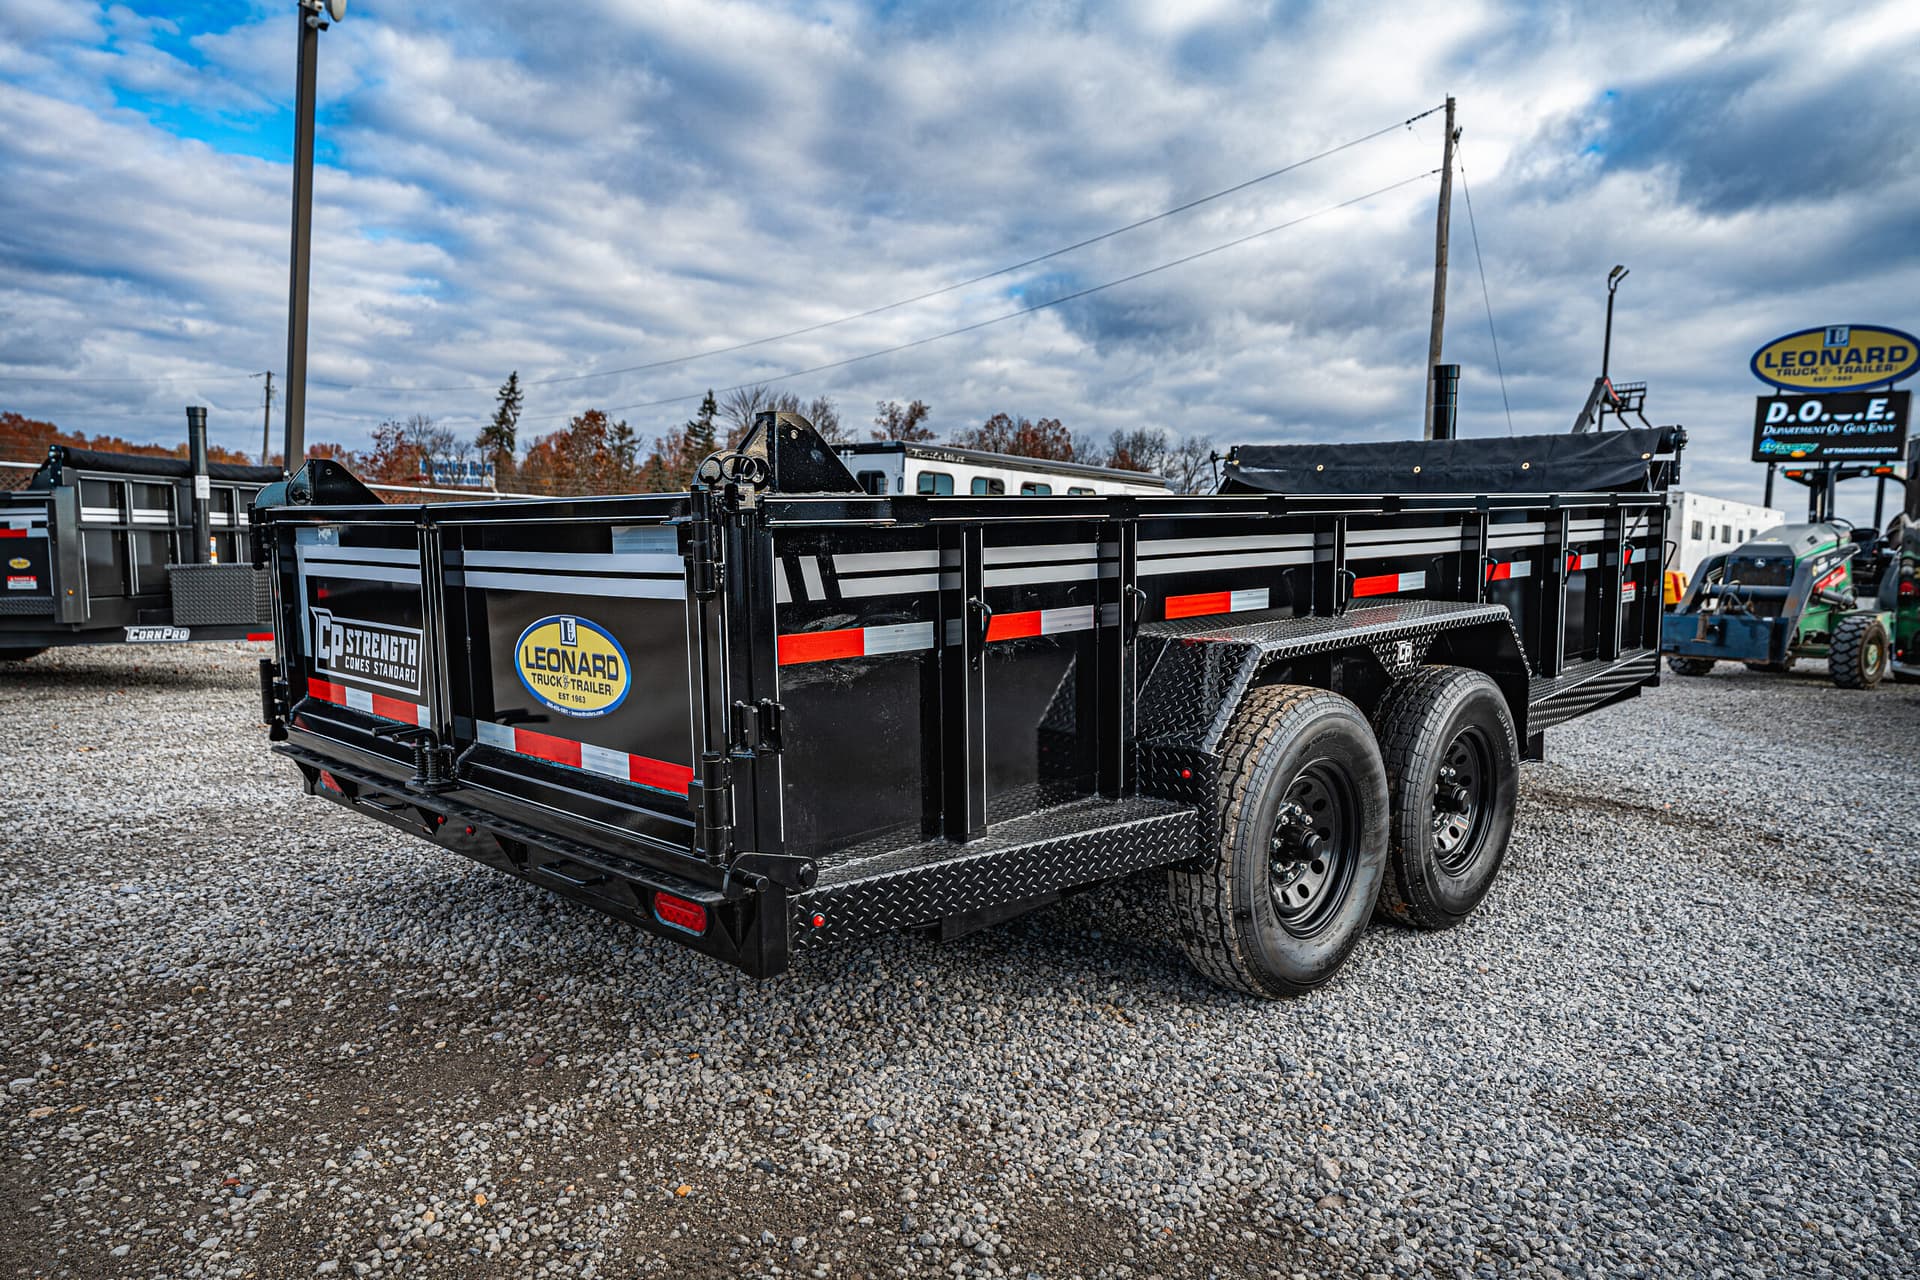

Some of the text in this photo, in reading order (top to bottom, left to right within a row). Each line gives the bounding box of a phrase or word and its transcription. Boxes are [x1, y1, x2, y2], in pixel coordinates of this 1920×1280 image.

[1764, 345, 1909, 368] LEONARD
[1776, 363, 1894, 377] TRUCK TRAILER
[318, 614, 418, 669] CP STRENGTH
[344, 655, 417, 684] COMES STANDARD
[524, 645, 619, 682] LEONARD
[531, 672, 563, 689] TRUCK
[570, 678, 612, 697] TRAILER
[558, 692, 570, 701] EST
